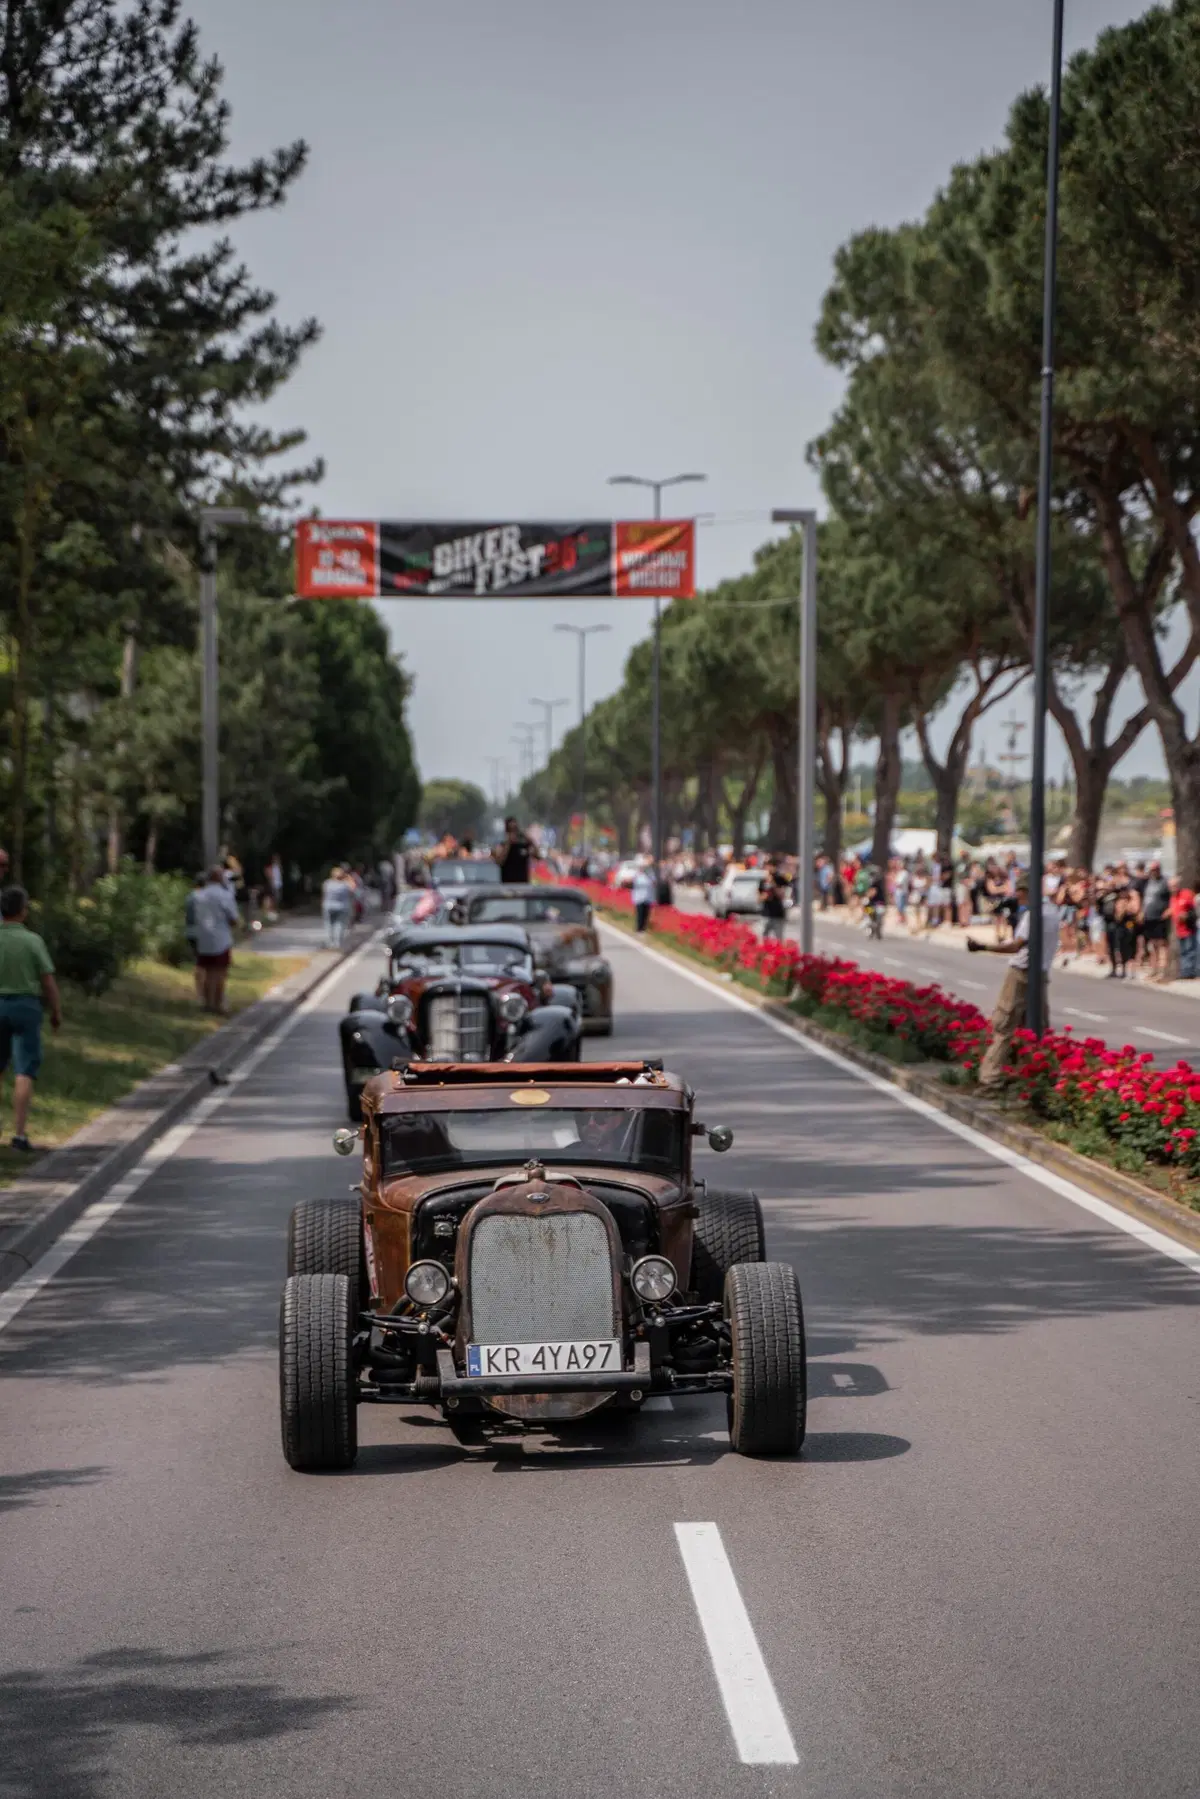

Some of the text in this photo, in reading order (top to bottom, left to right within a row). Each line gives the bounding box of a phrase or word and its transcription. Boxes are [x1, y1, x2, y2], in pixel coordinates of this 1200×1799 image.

[433, 524, 521, 577] BIKER
[474, 543, 546, 595] FEST
[470, 1364, 480, 1372] PL
[486, 1343, 613, 1373] KR 4YA97
